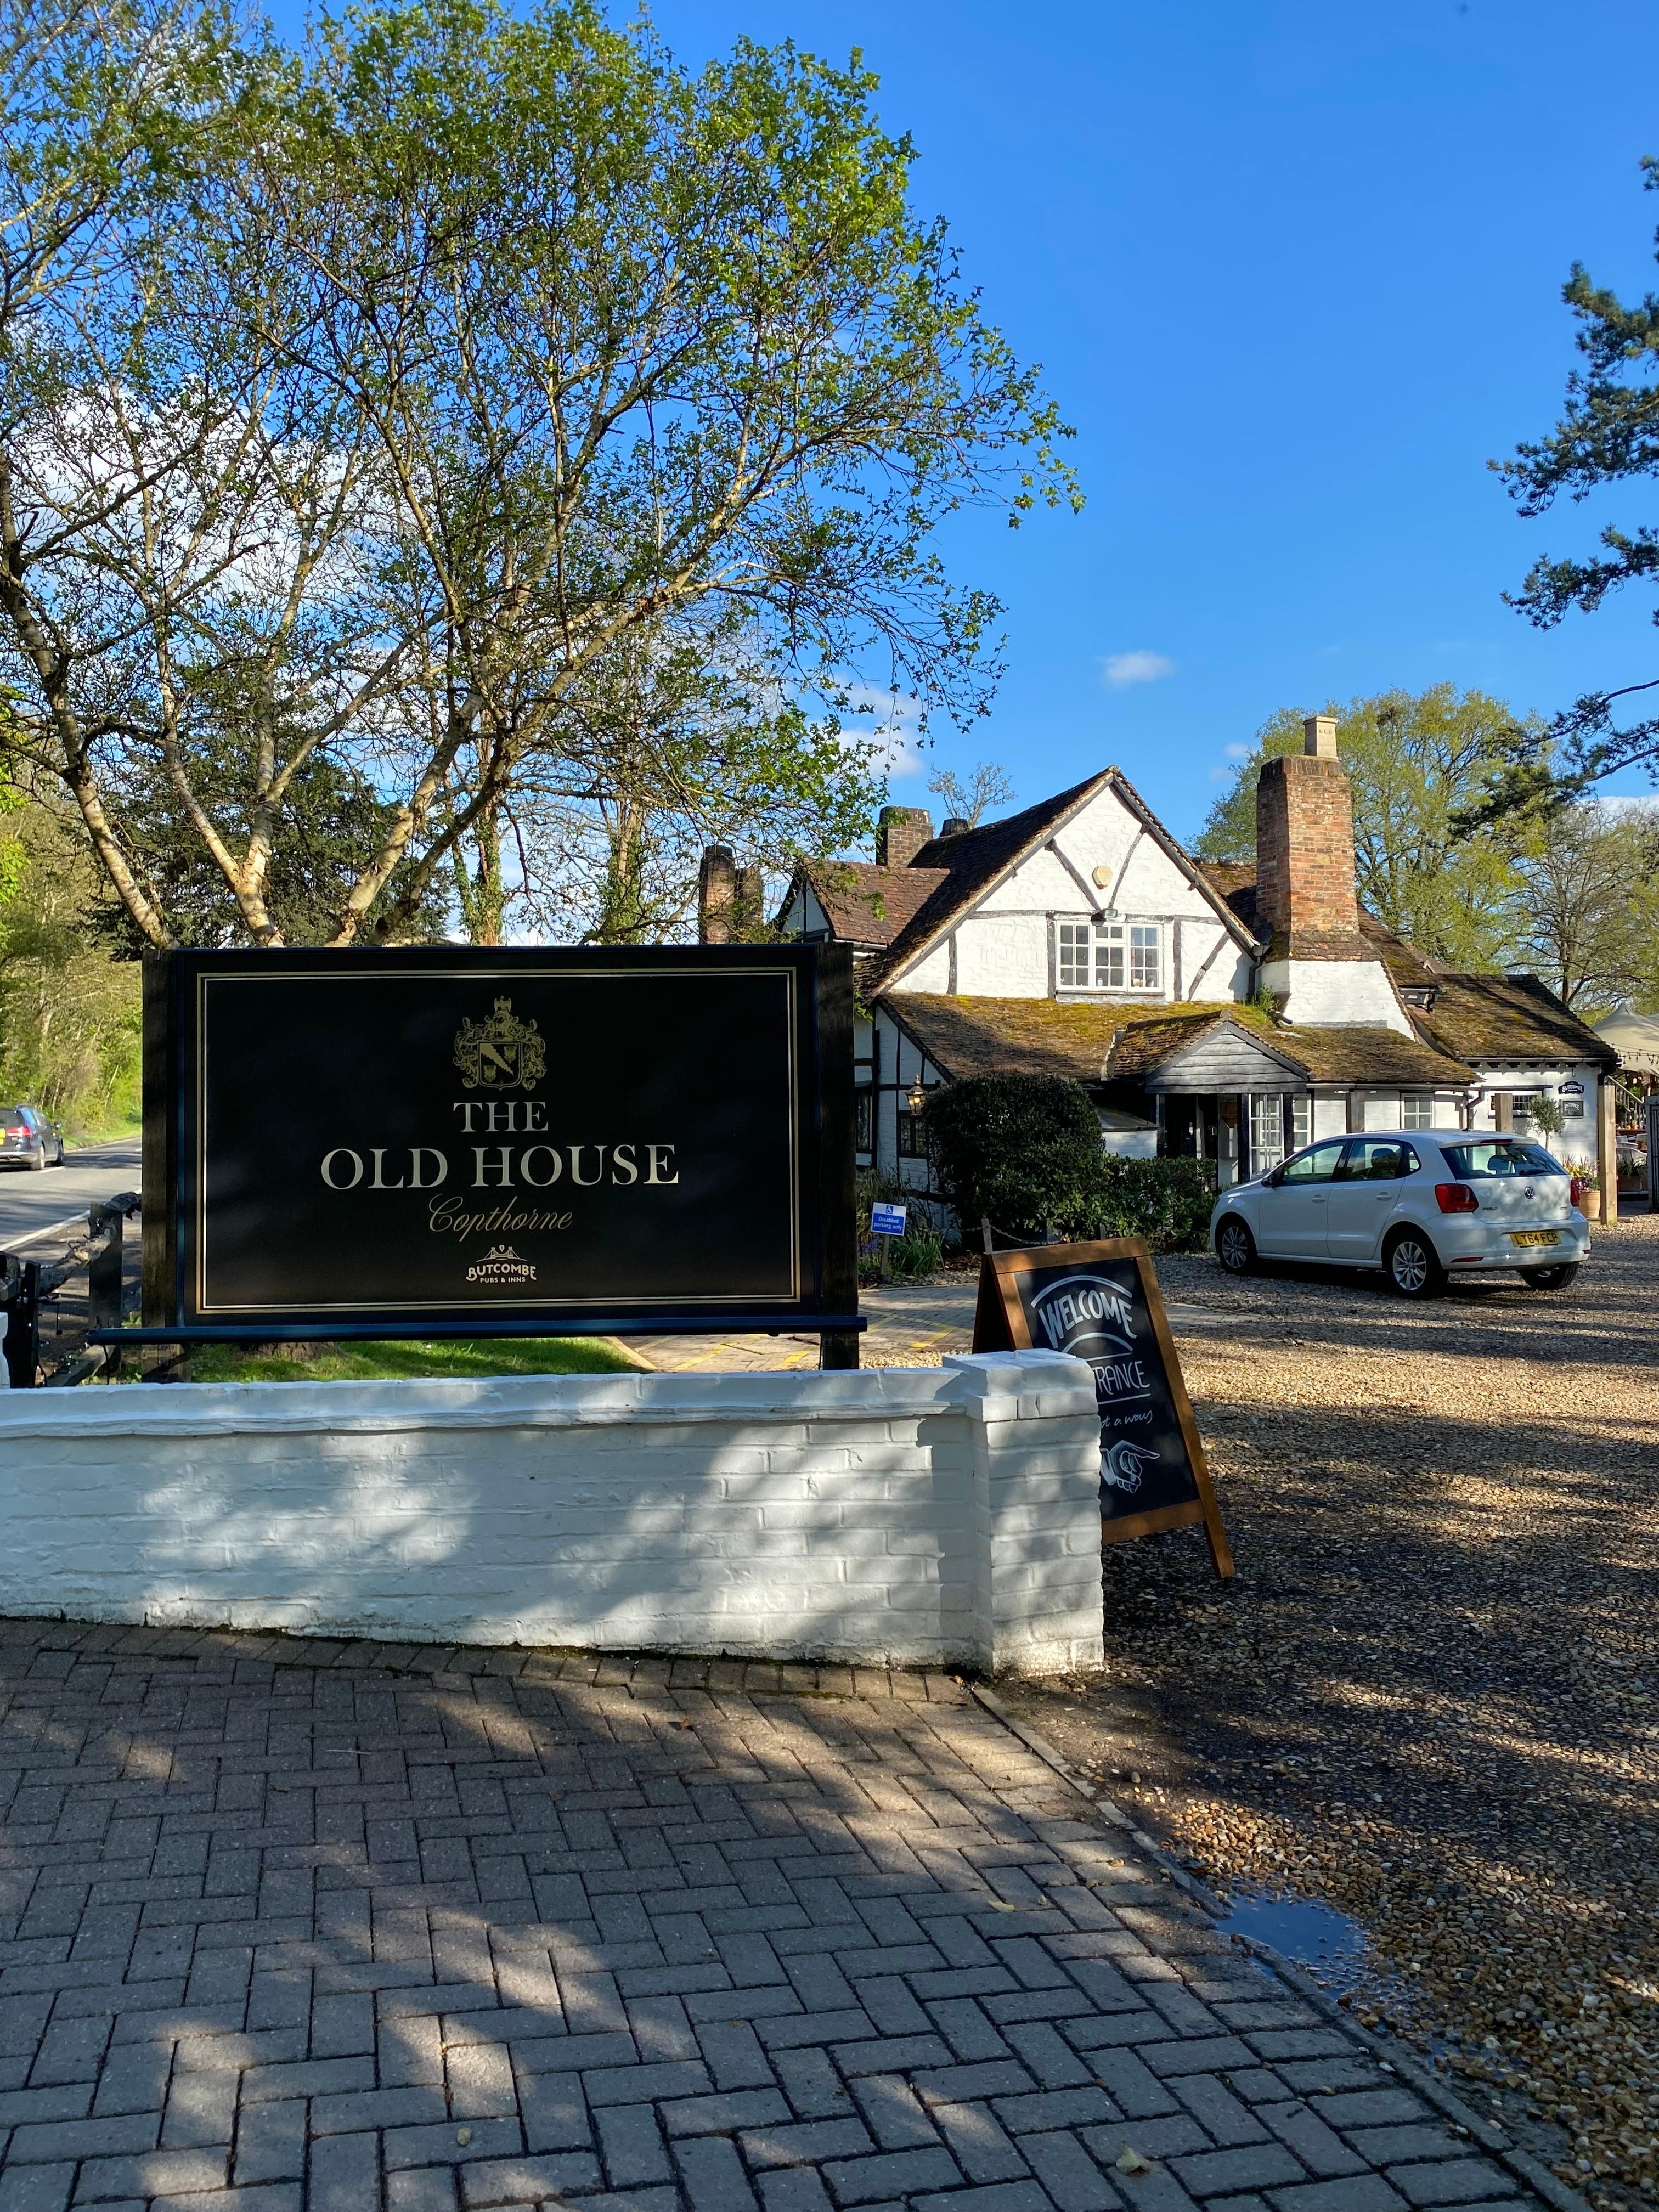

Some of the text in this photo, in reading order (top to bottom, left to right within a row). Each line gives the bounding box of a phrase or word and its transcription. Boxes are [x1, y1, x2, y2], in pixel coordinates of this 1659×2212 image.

[453, 1101, 548, 1132] THE
[321, 1144, 679, 1190] OLD HOUSE
[428, 1193, 573, 1242] Copthorne
[1515, 1234, 1539, 1245] LT64
[466, 1263, 537, 1282] BUTCOMBE
[1038, 1290, 1137, 1349] WELCOME
[1091, 1361, 1150, 1395] RANCE
